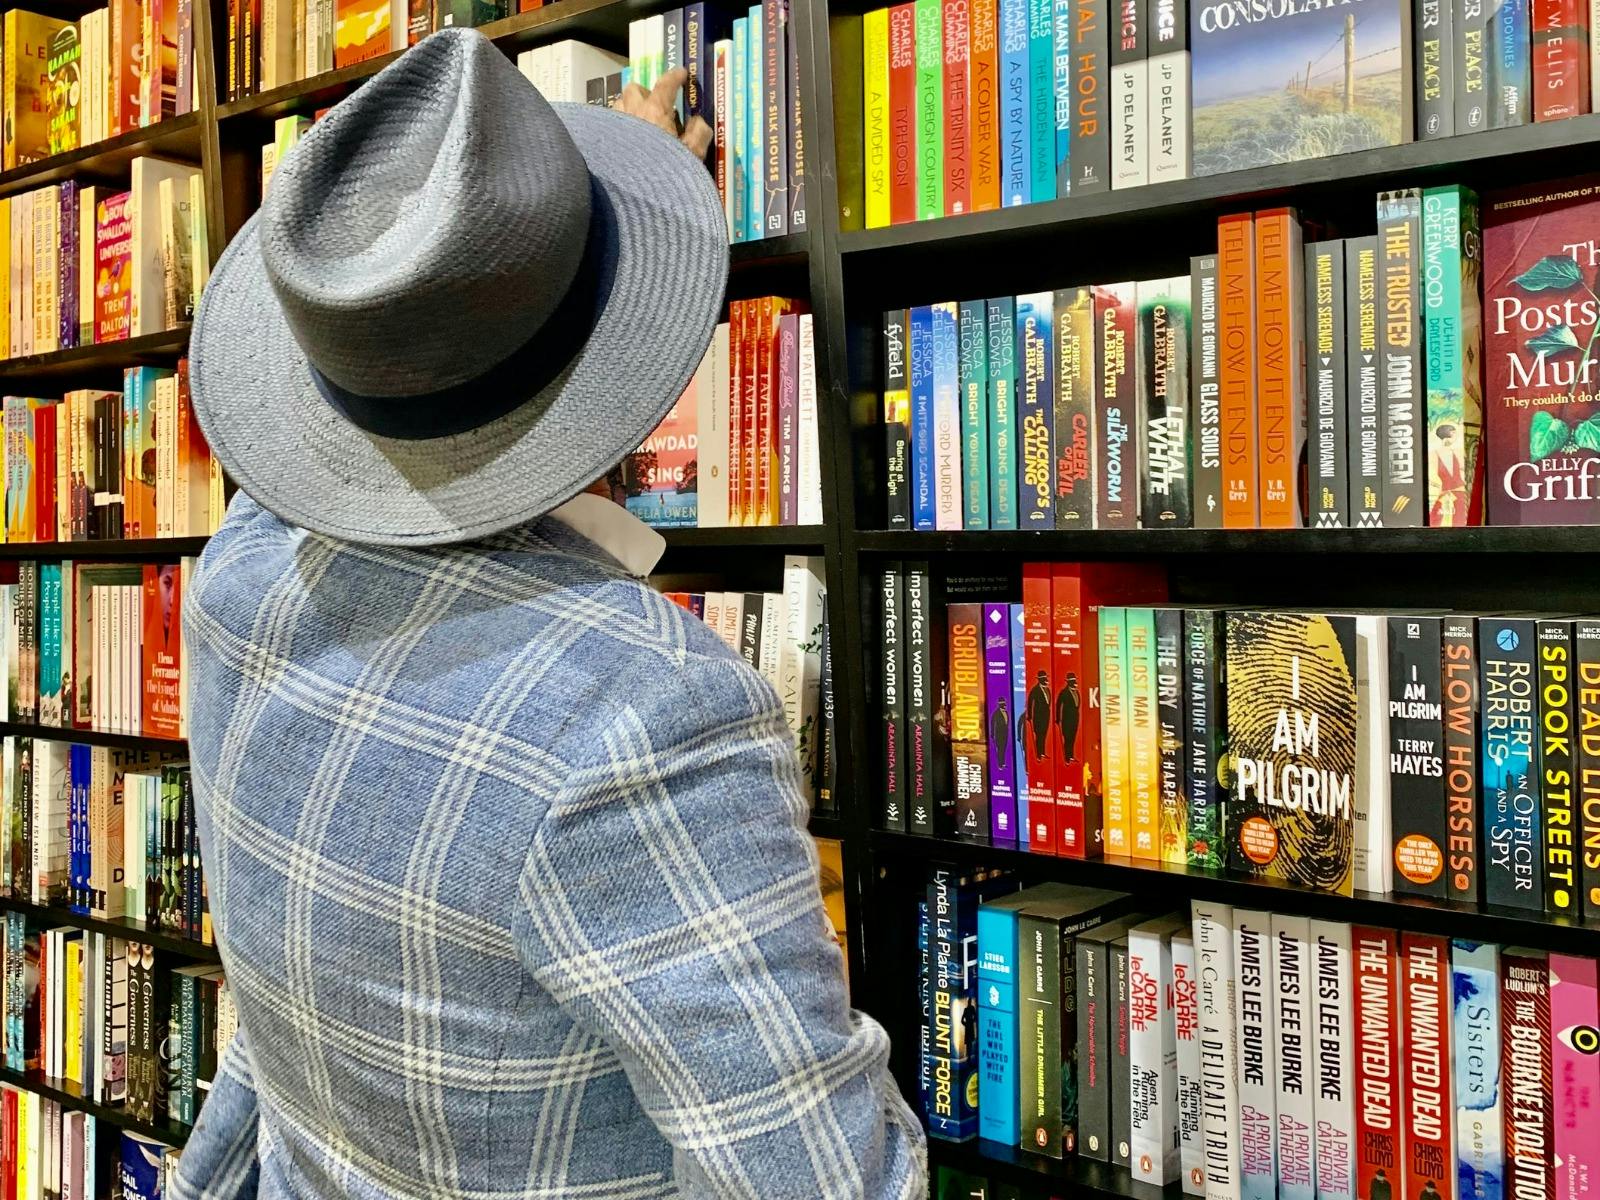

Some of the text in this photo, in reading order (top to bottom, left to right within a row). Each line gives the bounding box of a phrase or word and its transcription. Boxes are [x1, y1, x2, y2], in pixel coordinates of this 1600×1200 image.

[891, 13, 901, 69] CUMMING
[900, 9, 911, 68] CHARLES
[1504, 16, 1514, 69] DOWNES
[688, 62, 698, 108] EDUCATION
[1078, 53, 1098, 138] HOUR
[1423, 39, 1440, 101] PEACE
[717, 67, 725, 148] SALVATION CITY
[951, 71, 965, 191] THE TRINITY SIX
[977, 62, 992, 186] A COLDER WAR
[1010, 61, 1023, 190] A SPY BY NATURE
[1124, 73, 1134, 163] JP DELANEY
[769, 105, 778, 182] SILK HOUSE
[896, 105, 908, 187] TYPHOON
[1494, 186, 1593, 211] BESTSELLING AUTHOR OF
[1425, 196, 1443, 308] GREENWOOD
[1444, 207, 1457, 250] KERRY
[101, 315, 130, 335] DALTON
[104, 295, 128, 315] TRENT
[884, 322, 904, 380] fyfield
[962, 309, 973, 380] FELLOWES
[973, 316, 984, 370] JESSICA
[1025, 317, 1037, 404] GALBRAITH
[1036, 338, 1045, 382] ROBERT
[1104, 308, 1117, 399] GALBRAITH
[1116, 329, 1125, 375] ROBERT
[1225, 222, 1248, 466] TELL ME HOW IT ENDS
[1316, 254, 1335, 478] NAMELESS SERENADE MAURIZIO DE GIOVANNI
[803, 321, 812, 422] ANN PATCHETT
[1201, 277, 1220, 469] MAURIZIO DE GIOVANNI GLASS SOULS
[1503, 390, 1593, 409] They couldn't do
[783, 415, 791, 494] TIM PARKS
[1024, 416, 1037, 486] CALLING
[1073, 413, 1088, 480] CAREER
[1108, 407, 1122, 502] SILKWORM
[1149, 418, 1170, 496] WHITE
[1167, 406, 1184, 485] LETHAL
[1542, 458, 1582, 472] ELLY
[647, 466, 684, 483] SING
[920, 457, 930, 510] SCANDAL
[1058, 458, 1074, 498] EVIL
[43, 581, 51, 616] People
[44, 643, 50, 657] Us
[746, 613, 757, 644] PHILIP
[884, 571, 897, 705] imperfect women
[1444, 631, 1473, 639] HERRON
[152, 664, 180, 679] Ferrante
[157, 652, 174, 665] Elena
[953, 623, 980, 743] SCRUBLANDS
[1291, 655, 1300, 700] I
[152, 700, 180, 715] of Adults
[824, 690, 834, 719] 1939
[1389, 702, 1442, 720] PILGRIM
[1403, 683, 1426, 701] AM
[1486, 660, 1509, 761] HARRIS
[1509, 661, 1533, 762] ROBERT
[1133, 657, 1150, 824] LOST MAN HARPER
[1157, 674, 1178, 815] DRY JANE HARPER
[1191, 625, 1207, 831] FORCE OF NATURE JANE HARPER
[1271, 705, 1319, 757] AM
[1398, 739, 1434, 754] TERRY
[112, 751, 149, 767] THE
[957, 756, 971, 800] HAMMER
[969, 764, 982, 794] CHRIS
[1390, 753, 1443, 777] HAYES
[1447, 644, 1474, 872] SLOW HORSES
[1543, 646, 1573, 887] SPOOK STREET
[1580, 662, 1600, 873] DEAD LIONS
[1237, 756, 1350, 821] PILGRIM
[1514, 774, 1534, 891] AN OFFICER
[934, 870, 950, 917] Lynda
[1197, 908, 1212, 944] John
[937, 943, 950, 989] Plante
[979, 960, 1010, 975] LARSSON
[1201, 948, 1217, 962] le
[1509, 967, 1540, 981] ROBERT
[142, 981, 153, 1050] Governess
[1131, 956, 1149, 1032] leCARRÉ
[1144, 973, 1158, 1022] JOHN
[1201, 966, 1218, 1015] Carré
[1240, 925, 1264, 1086] JAMES LEE BURKE
[1505, 979, 1546, 996] LUDLUM'S
[936, 990, 950, 1055] BLUNT
[1360, 940, 1391, 1130] THE UNWANTED DEAD
[1467, 1005, 1491, 1093] Sisters
[982, 1050, 1009, 1063] PLAYED
[1202, 1041, 1226, 1121] DELICATE
[1511, 1000, 1543, 1106] THE BOURNE
[936, 1056, 951, 1117] FORCE
[1140, 1071, 1150, 1121] Running
[1149, 1070, 1159, 1106] Agent
[1205, 1129, 1230, 1184] TRUTH
[1242, 1105, 1257, 1177] CATHEDRAL
[1364, 1132, 1393, 1152] CHRIS
[1364, 1149, 1393, 1169] LLOYD
[122, 1171, 139, 1190] GAIL
